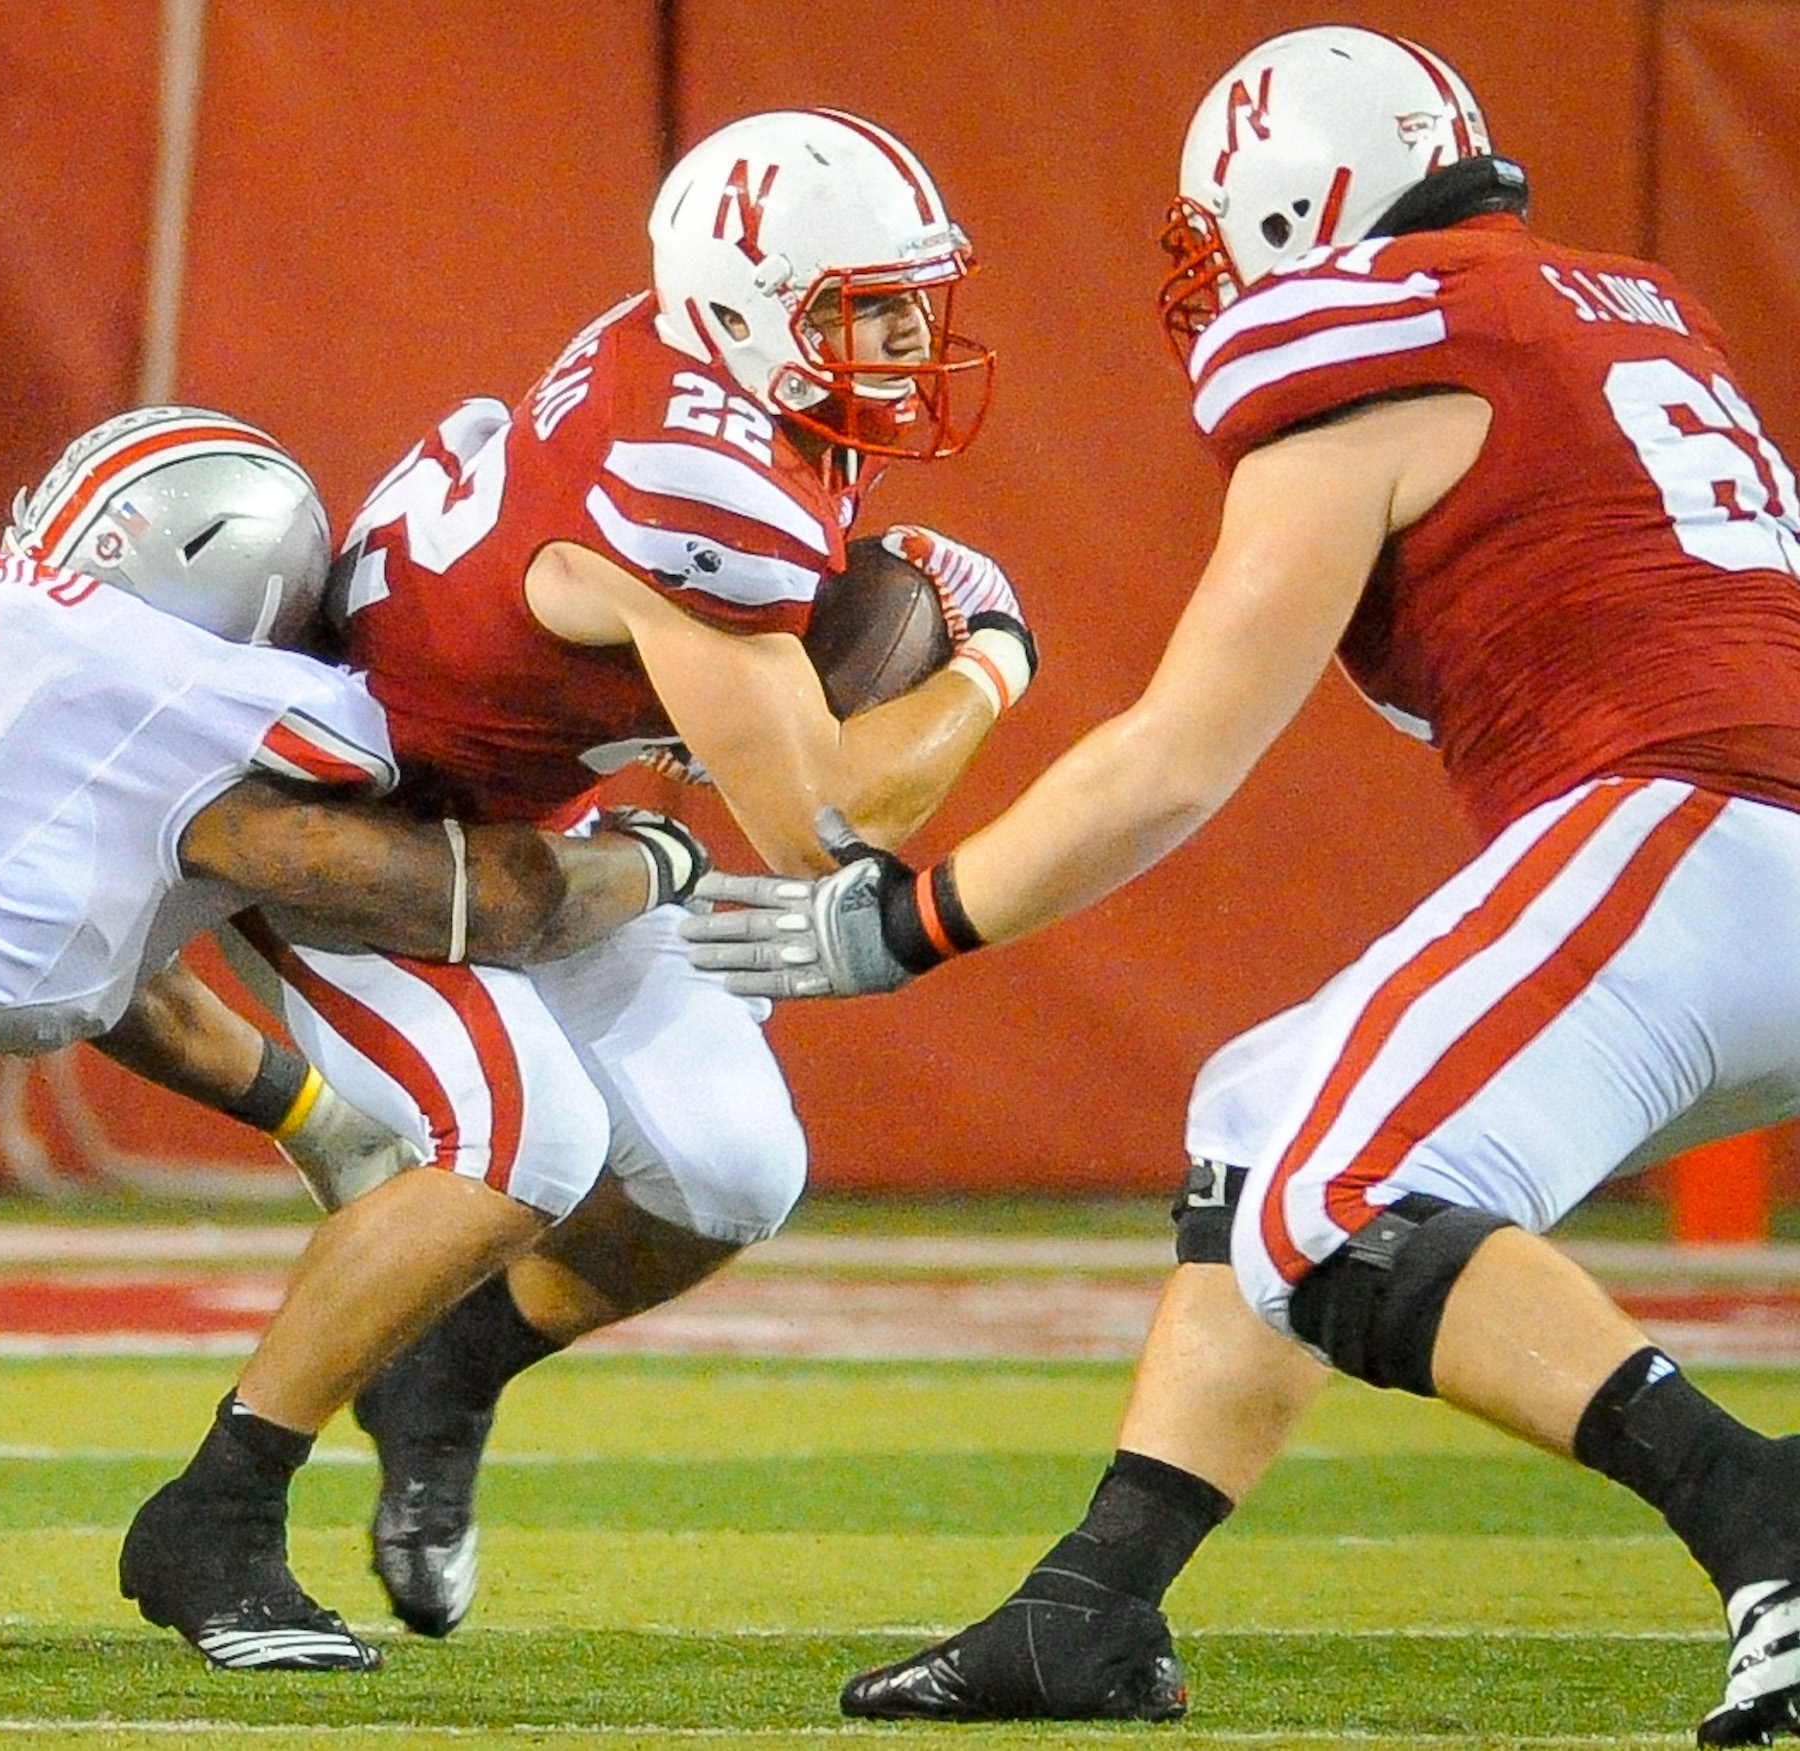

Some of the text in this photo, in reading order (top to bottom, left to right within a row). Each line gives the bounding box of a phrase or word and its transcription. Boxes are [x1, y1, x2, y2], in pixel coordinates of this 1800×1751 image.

[1213, 67, 1273, 187] N
[712, 158, 780, 267] N
[663, 372, 773, 468] 22
